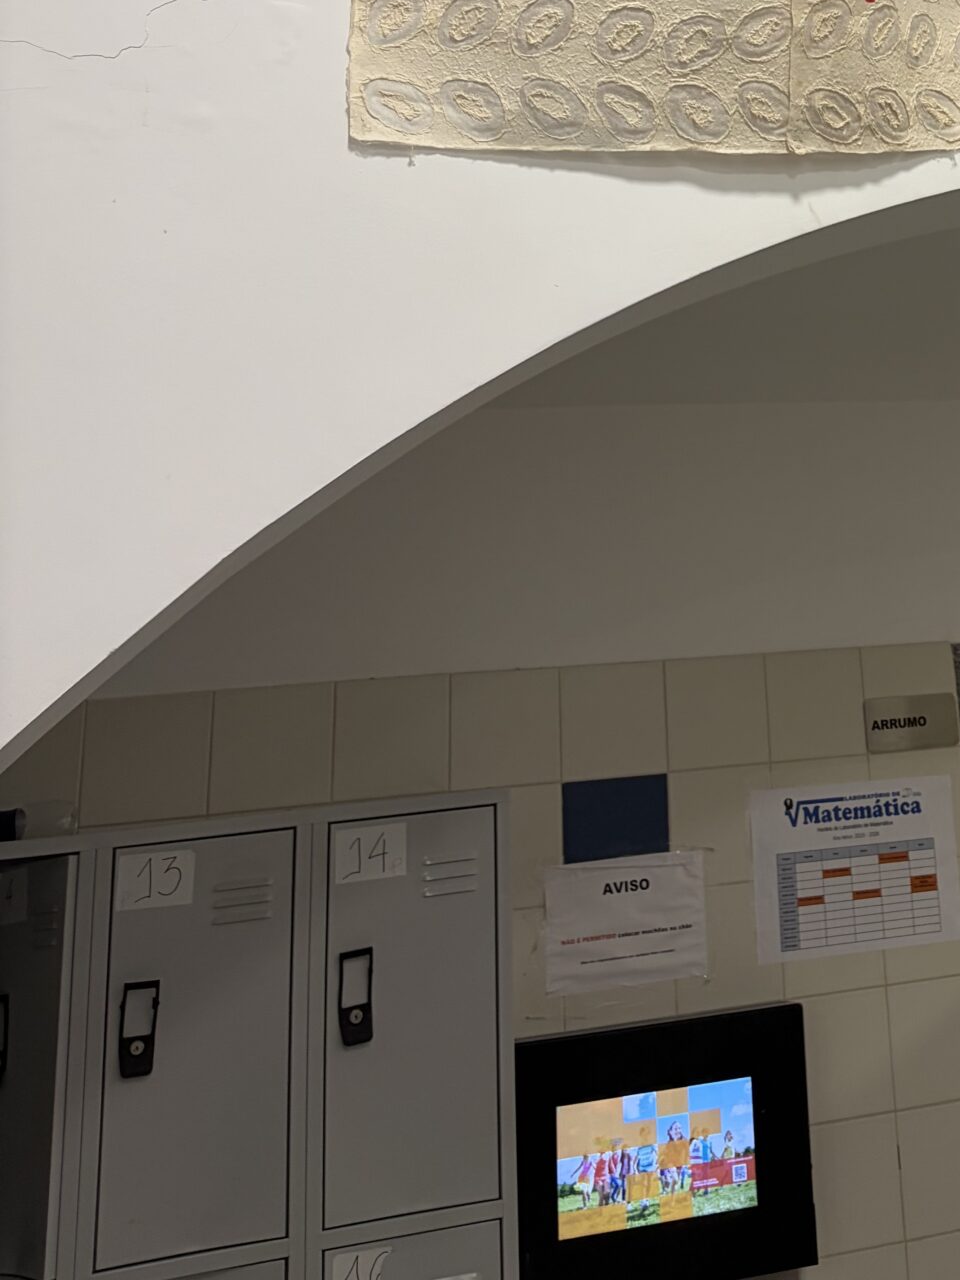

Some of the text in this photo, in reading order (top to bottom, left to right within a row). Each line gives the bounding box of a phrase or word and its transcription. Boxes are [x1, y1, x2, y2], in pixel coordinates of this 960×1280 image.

[871, 715, 927, 731] ARRUMO
[802, 798, 922, 825] Matemática
[342, 831, 388, 880] 14
[133, 856, 183, 904] 13
[602, 878, 650, 895] AVISO
